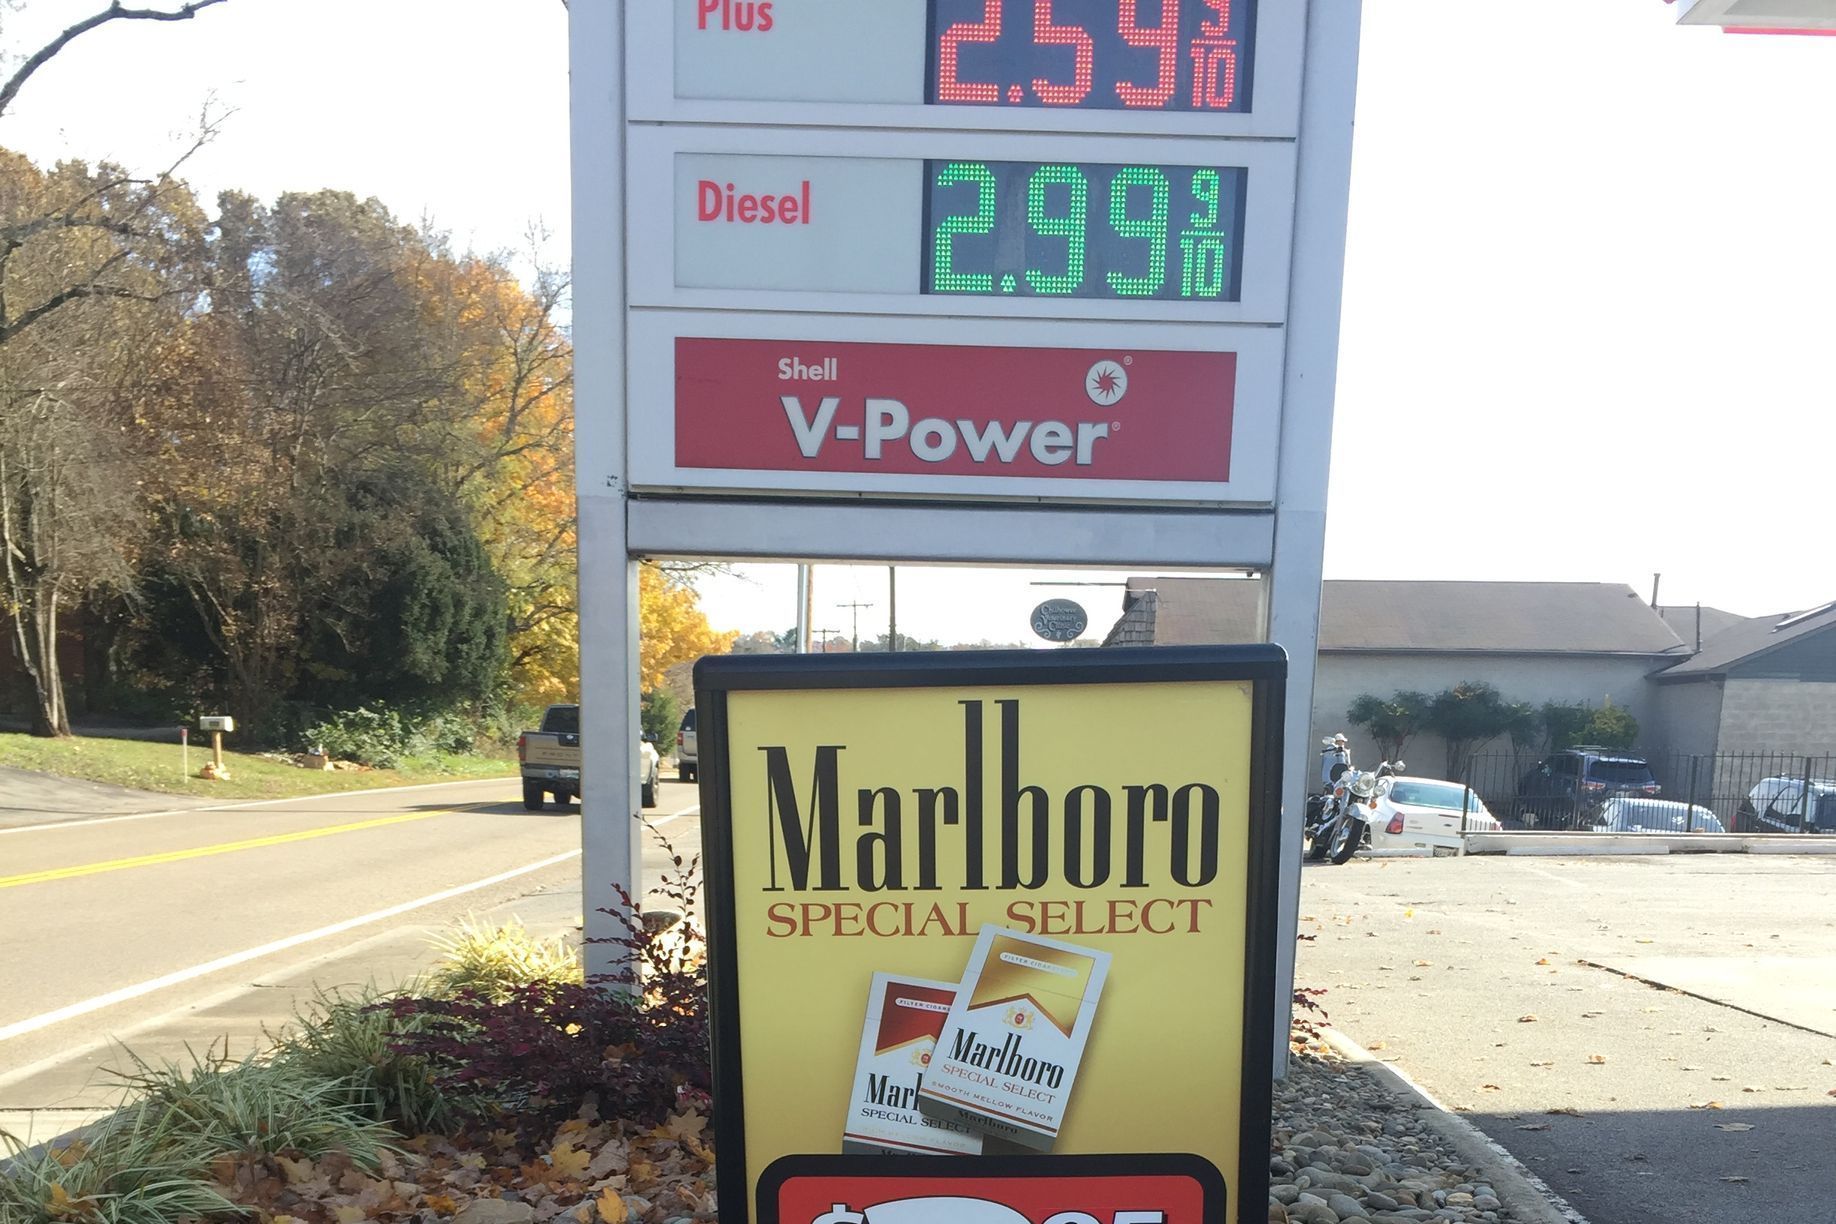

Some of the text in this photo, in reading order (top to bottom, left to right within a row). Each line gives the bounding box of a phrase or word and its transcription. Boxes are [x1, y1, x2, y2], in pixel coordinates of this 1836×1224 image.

[697, 0, 773, 31] Plus
[697, 180, 811, 224] Diesel
[934, 163, 1169, 297] 2.99
[777, 357, 838, 381] Shell
[779, 396, 1109, 466] V-Power
[757, 699, 1221, 893] Marlboro
[765, 899, 1214, 938] SPECIAL SELECT
[946, 1027, 1065, 1090] Marlboro
[941, 1063, 1057, 1105] SPECIAL SELECT
[860, 1107, 972, 1135] SPECIAL SELECT
[973, 1092, 1014, 1110] MELLOW
[1015, 1106, 1054, 1123] FLAVOR
